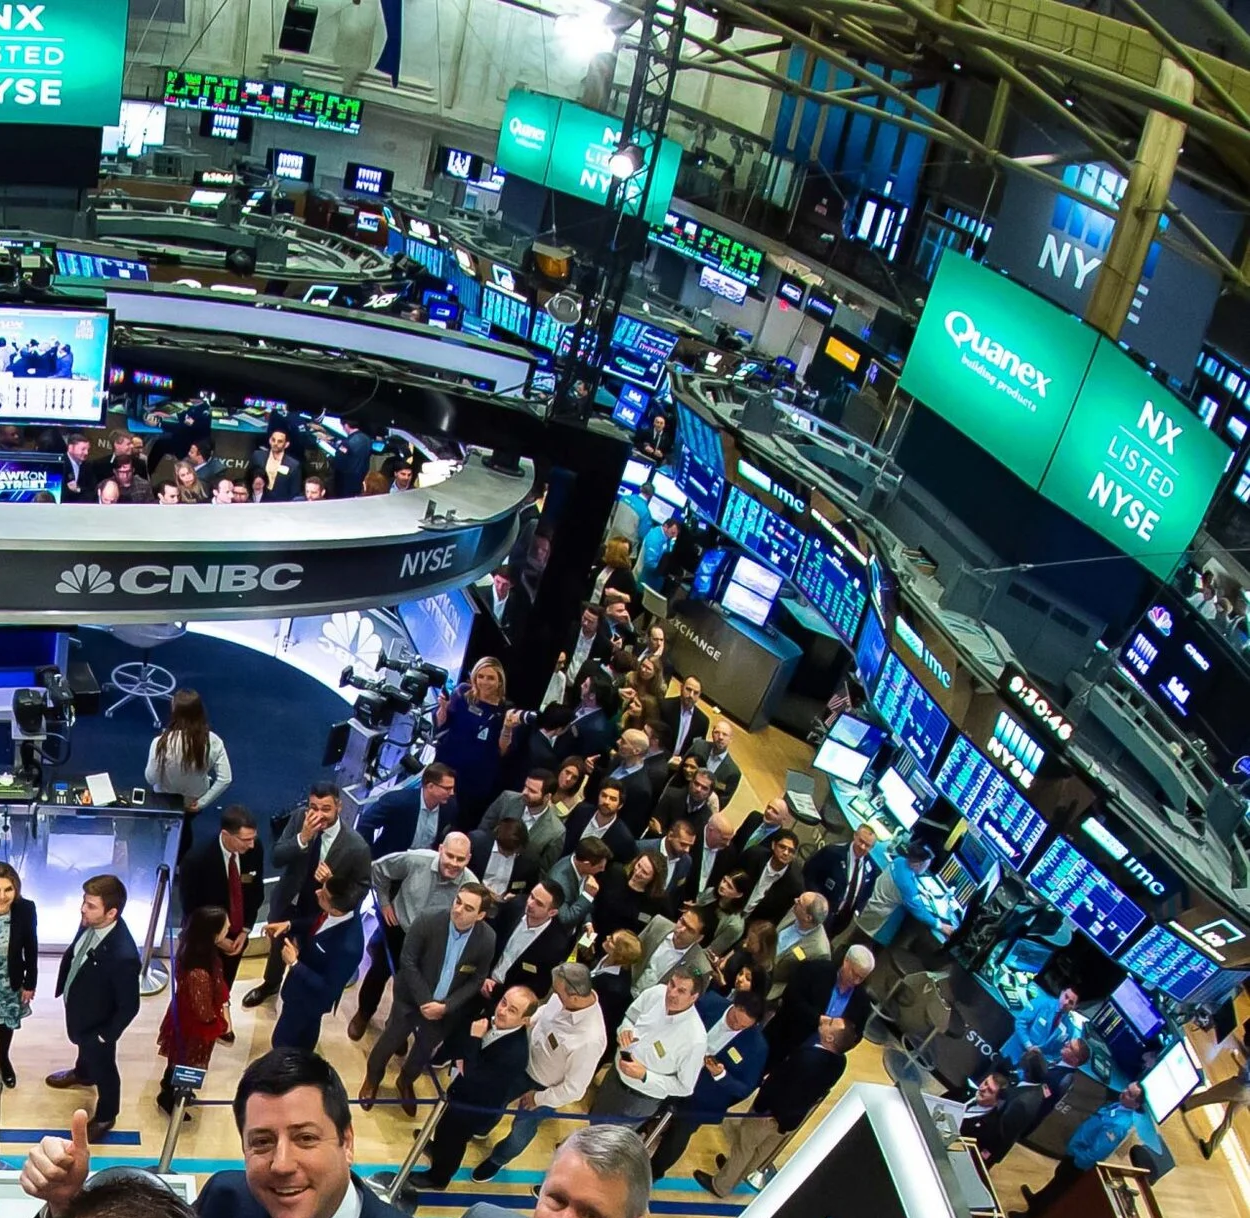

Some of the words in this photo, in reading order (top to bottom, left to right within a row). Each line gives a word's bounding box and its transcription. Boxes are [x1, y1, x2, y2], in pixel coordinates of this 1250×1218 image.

[1038, 233, 1150, 325] NYE
[944, 310, 1052, 398] Quanex
[961, 352, 997, 386] building
[997, 380, 1037, 413] products
[1137, 400, 1183, 455] NX
[1107, 435, 1174, 498] LISTED
[1088, 472, 1161, 542] NYSE
[119, 564, 304, 594] CNBC
[399, 544, 456, 577] NYSE
[1126, 648, 1150, 675] NYSE
[1009, 676, 1073, 741] 9:30:46
[987, 736, 1035, 790] NYSE
